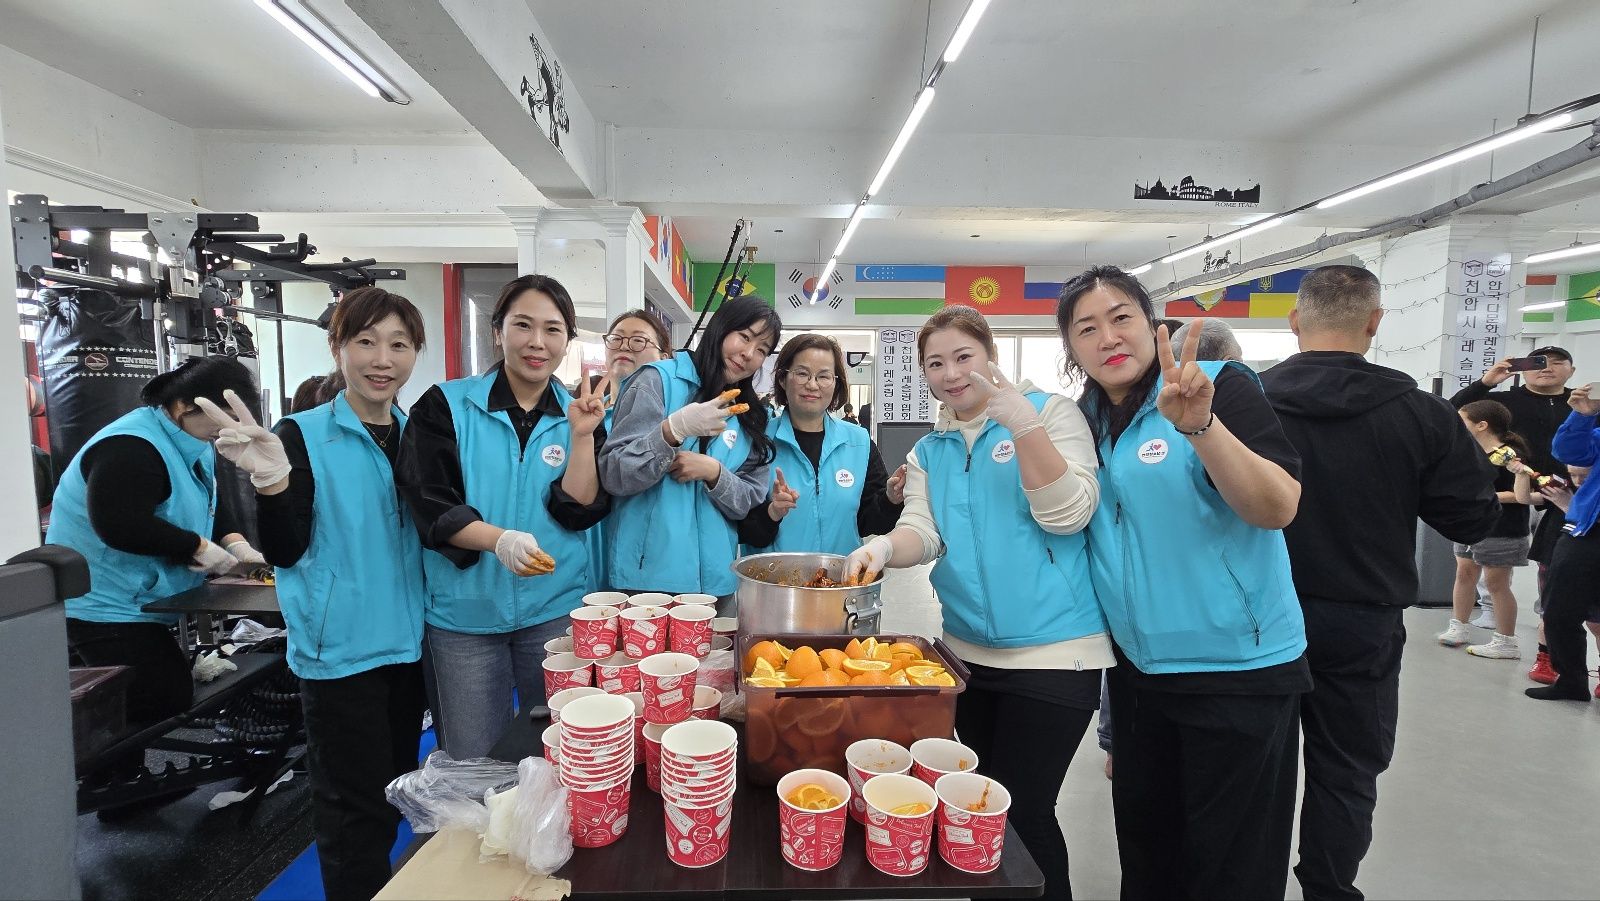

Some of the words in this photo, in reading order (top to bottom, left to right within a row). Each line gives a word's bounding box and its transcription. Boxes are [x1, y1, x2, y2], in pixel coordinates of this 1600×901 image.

[1462, 280, 1478, 328] 천안시
[884, 346, 894, 364] 대한
[901, 347, 912, 372] 천안시
